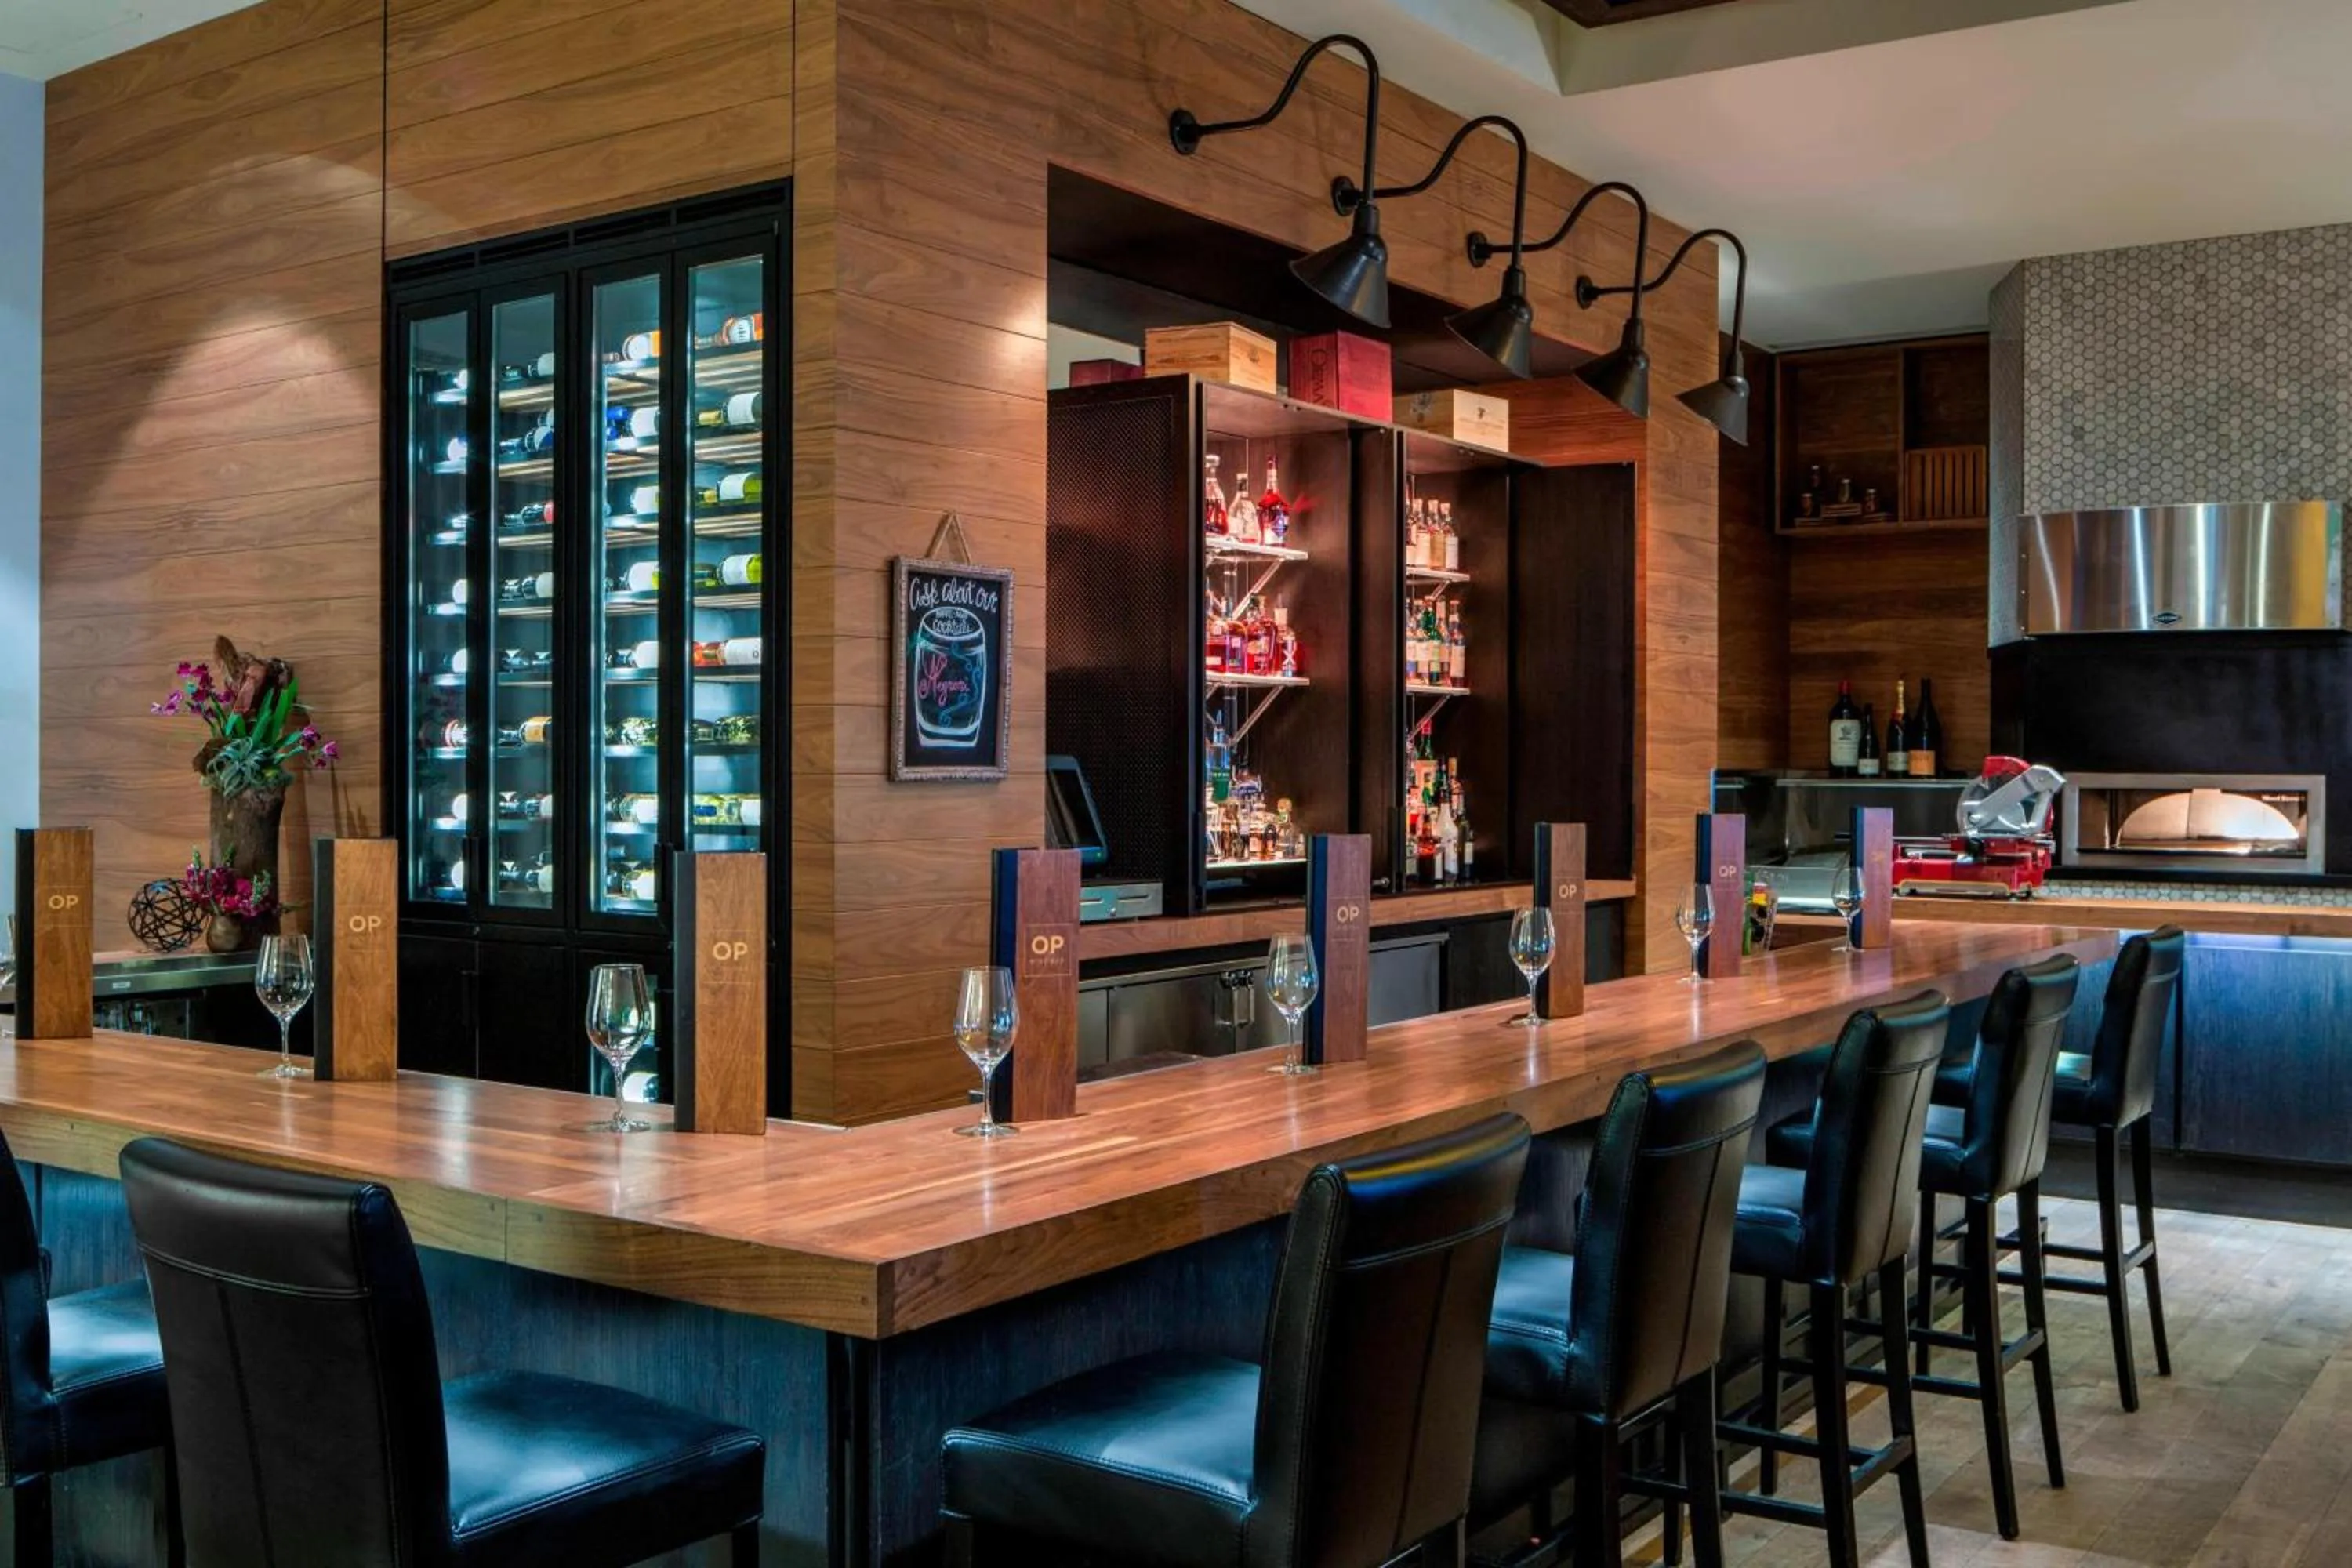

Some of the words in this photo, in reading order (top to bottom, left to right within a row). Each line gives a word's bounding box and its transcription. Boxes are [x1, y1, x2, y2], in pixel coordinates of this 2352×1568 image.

[942, 577, 976, 604] about
[975, 587, 998, 613] our
[1719, 865, 1737, 877] OP
[1559, 884, 1577, 898] OP
[48, 895, 79, 910] OP
[1337, 906, 1359, 923] OP
[349, 915, 382, 933] OP
[712, 942, 748, 960] OP
[1031, 935, 1064, 954] OP
